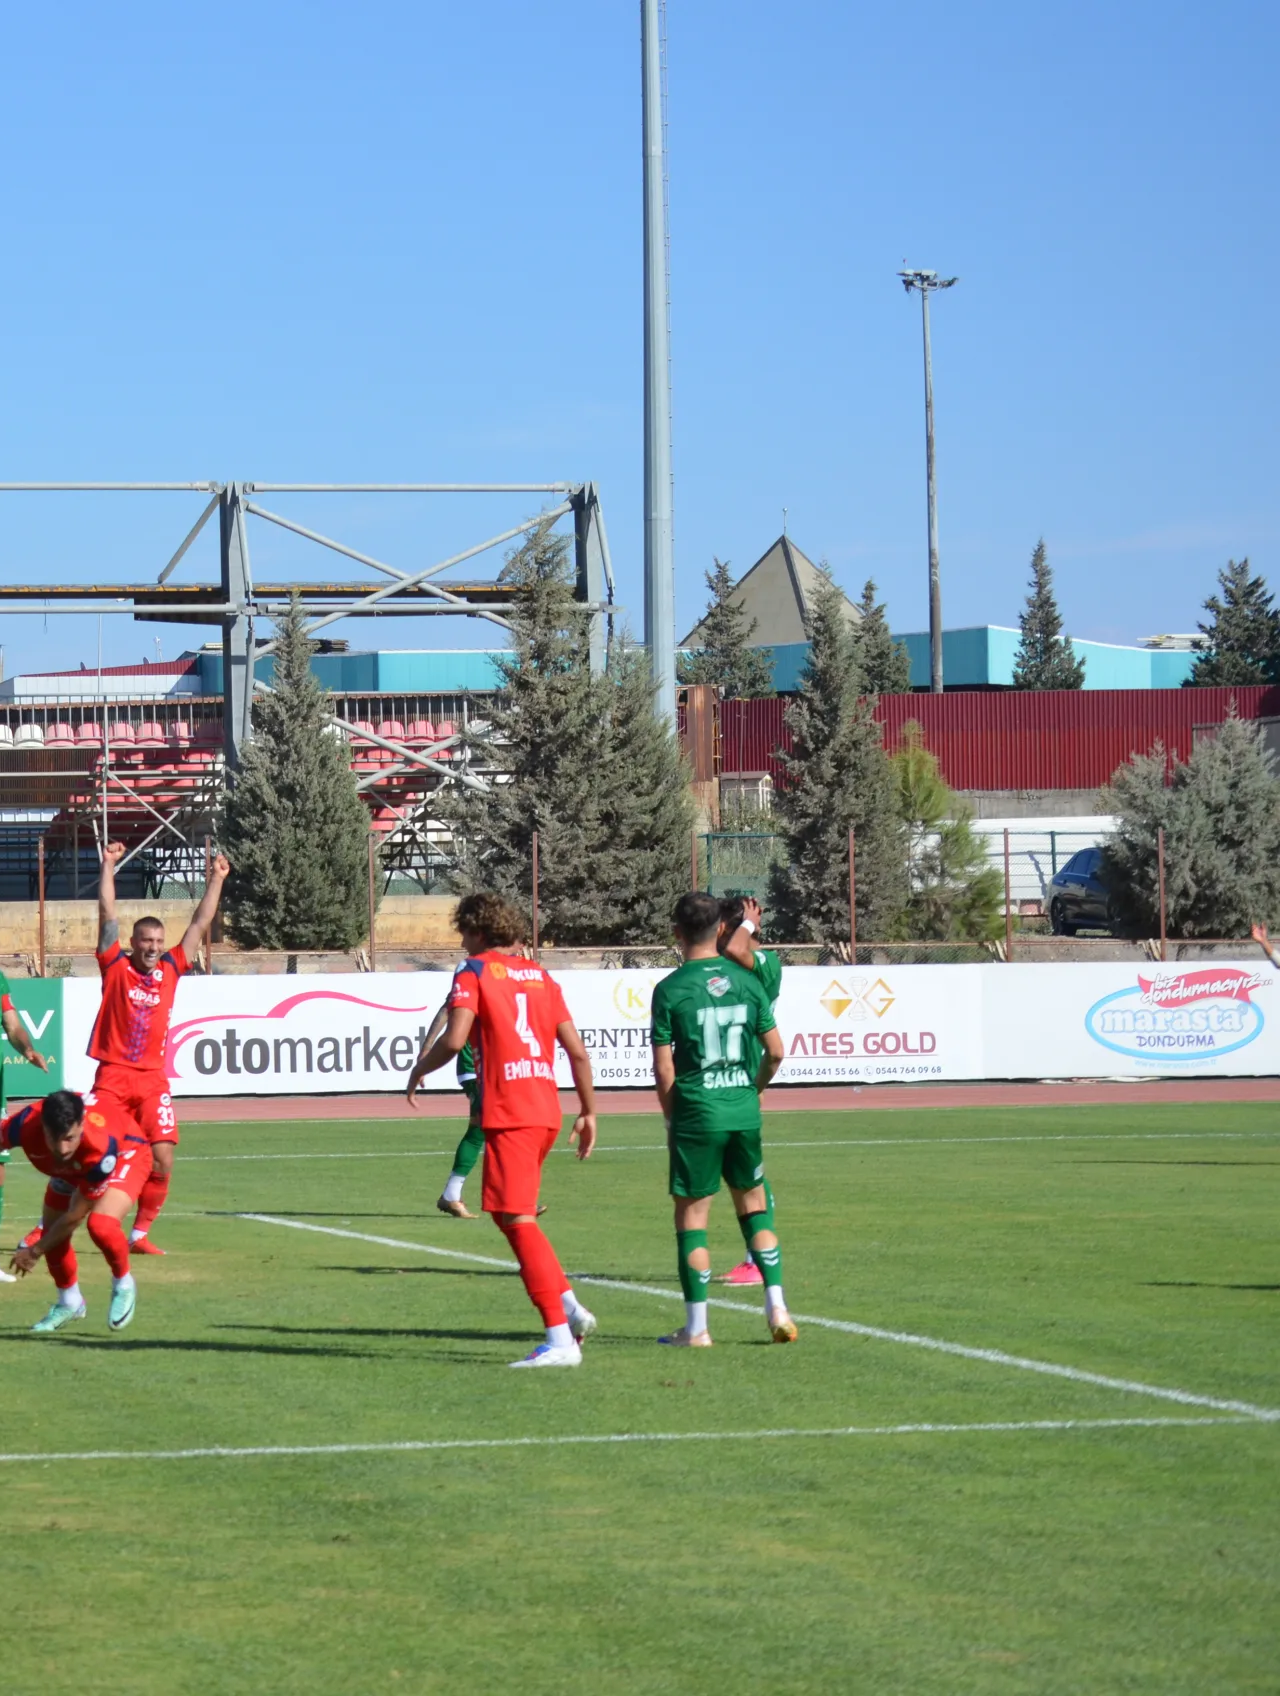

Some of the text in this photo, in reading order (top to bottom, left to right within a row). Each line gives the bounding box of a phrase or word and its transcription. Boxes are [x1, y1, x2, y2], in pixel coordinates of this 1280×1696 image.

[515, 993, 541, 1057] 4
[1101, 1005, 1244, 1034] marasta
[697, 1004, 748, 1070] 17
[863, 1031, 937, 1054] GOLD
[1136, 1034, 1216, 1048] DONDURMA
[600, 1068, 631, 1078] 0505
[703, 1066, 750, 1089] SALİH
[790, 1068, 860, 1077] 0344 241 55 66
[875, 1067, 898, 1075] 0544
[918, 1066, 929, 1074] 09
[931, 1066, 942, 1074] 68
[157, 1106, 175, 1128] 33
